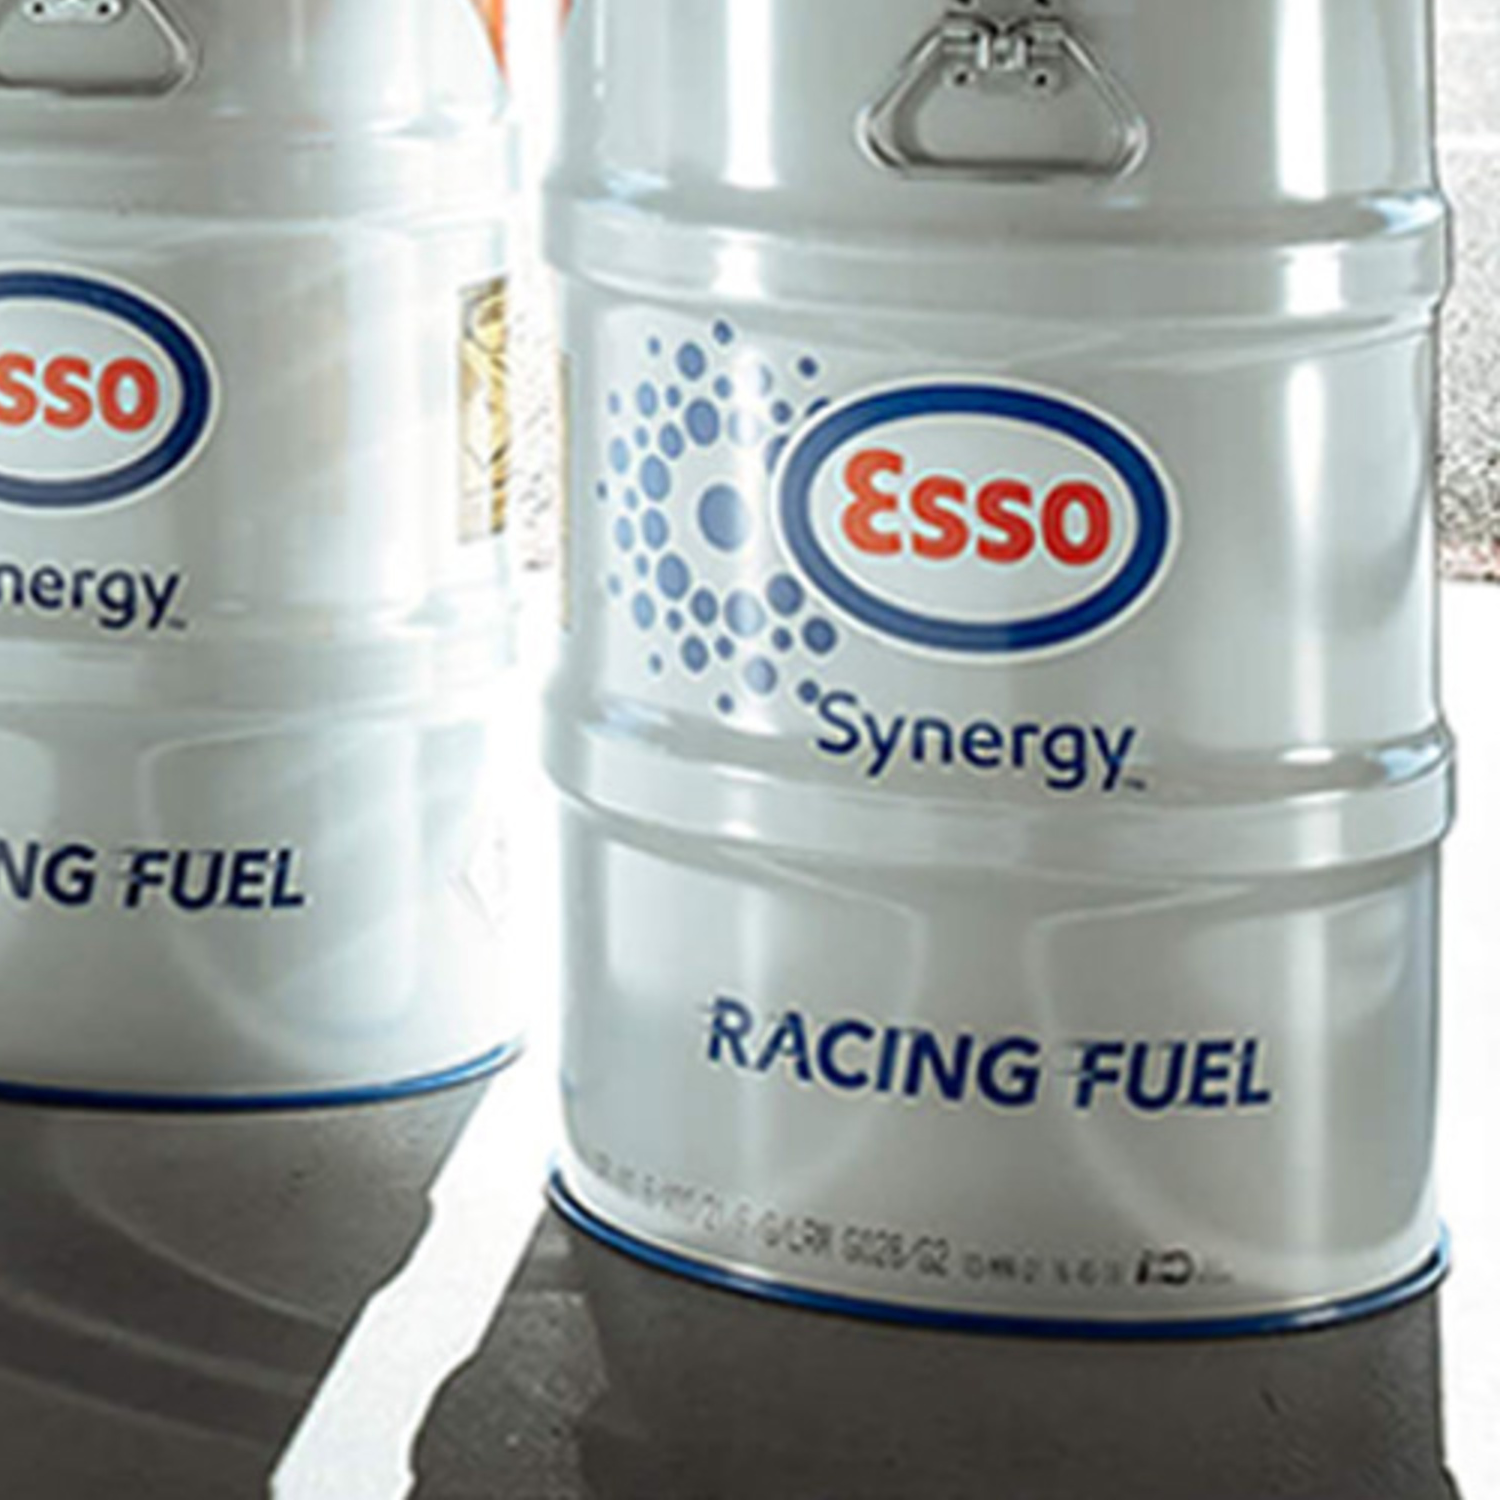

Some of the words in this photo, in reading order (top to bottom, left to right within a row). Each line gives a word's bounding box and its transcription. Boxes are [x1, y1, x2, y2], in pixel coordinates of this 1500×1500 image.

[842, 448, 1113, 567] Esso
[814, 692, 1138, 791] Synergy
[122, 848, 307, 910] FUEL
[704, 996, 1041, 1107] RACING
[1072, 1038, 1271, 1111] FUEL
